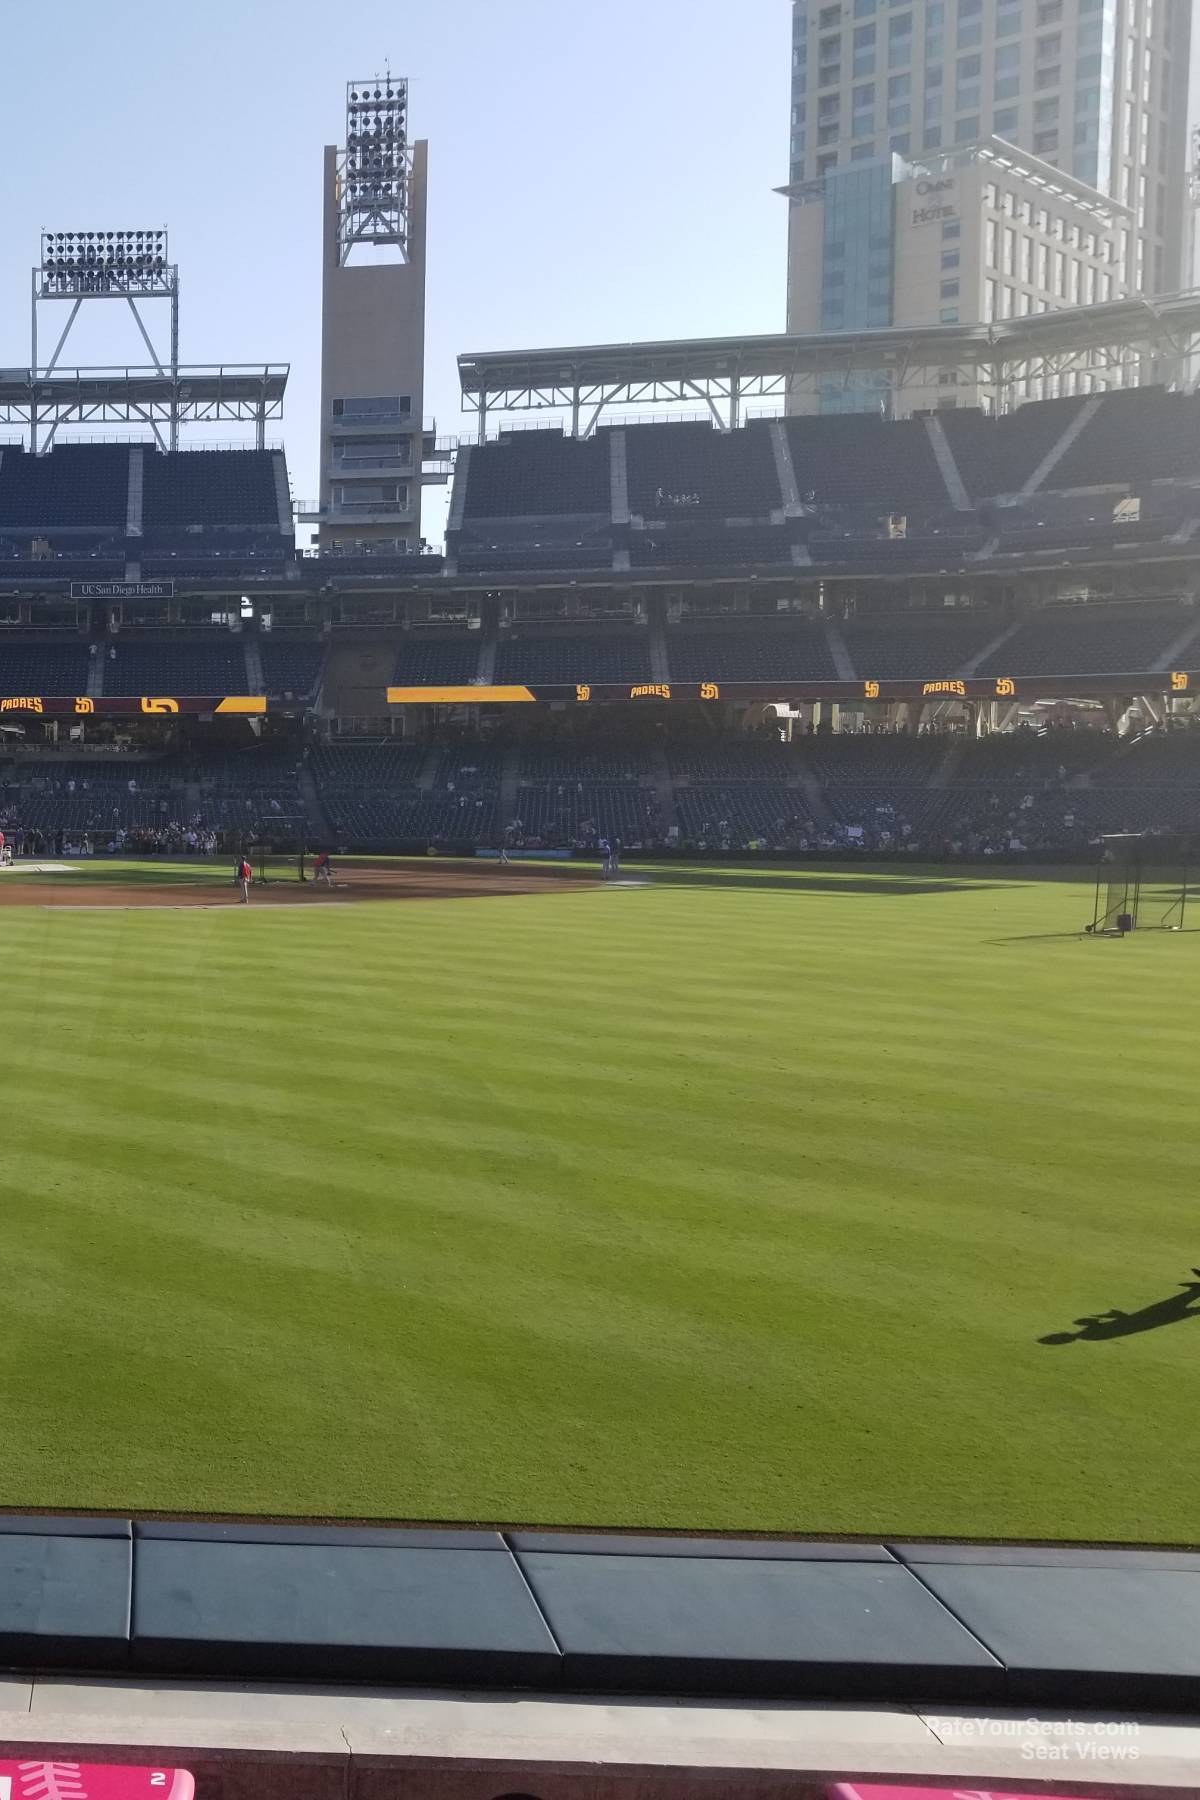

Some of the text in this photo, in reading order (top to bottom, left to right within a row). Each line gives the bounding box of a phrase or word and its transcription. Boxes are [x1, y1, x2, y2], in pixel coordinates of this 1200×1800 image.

[81, 584, 163, 596] UC San Diego Health
[630, 683, 671, 699] PADRES
[922, 680, 966, 696] PADRES
[0, 697, 44, 713] PADRES
[150, 1772, 166, 1786] 2
